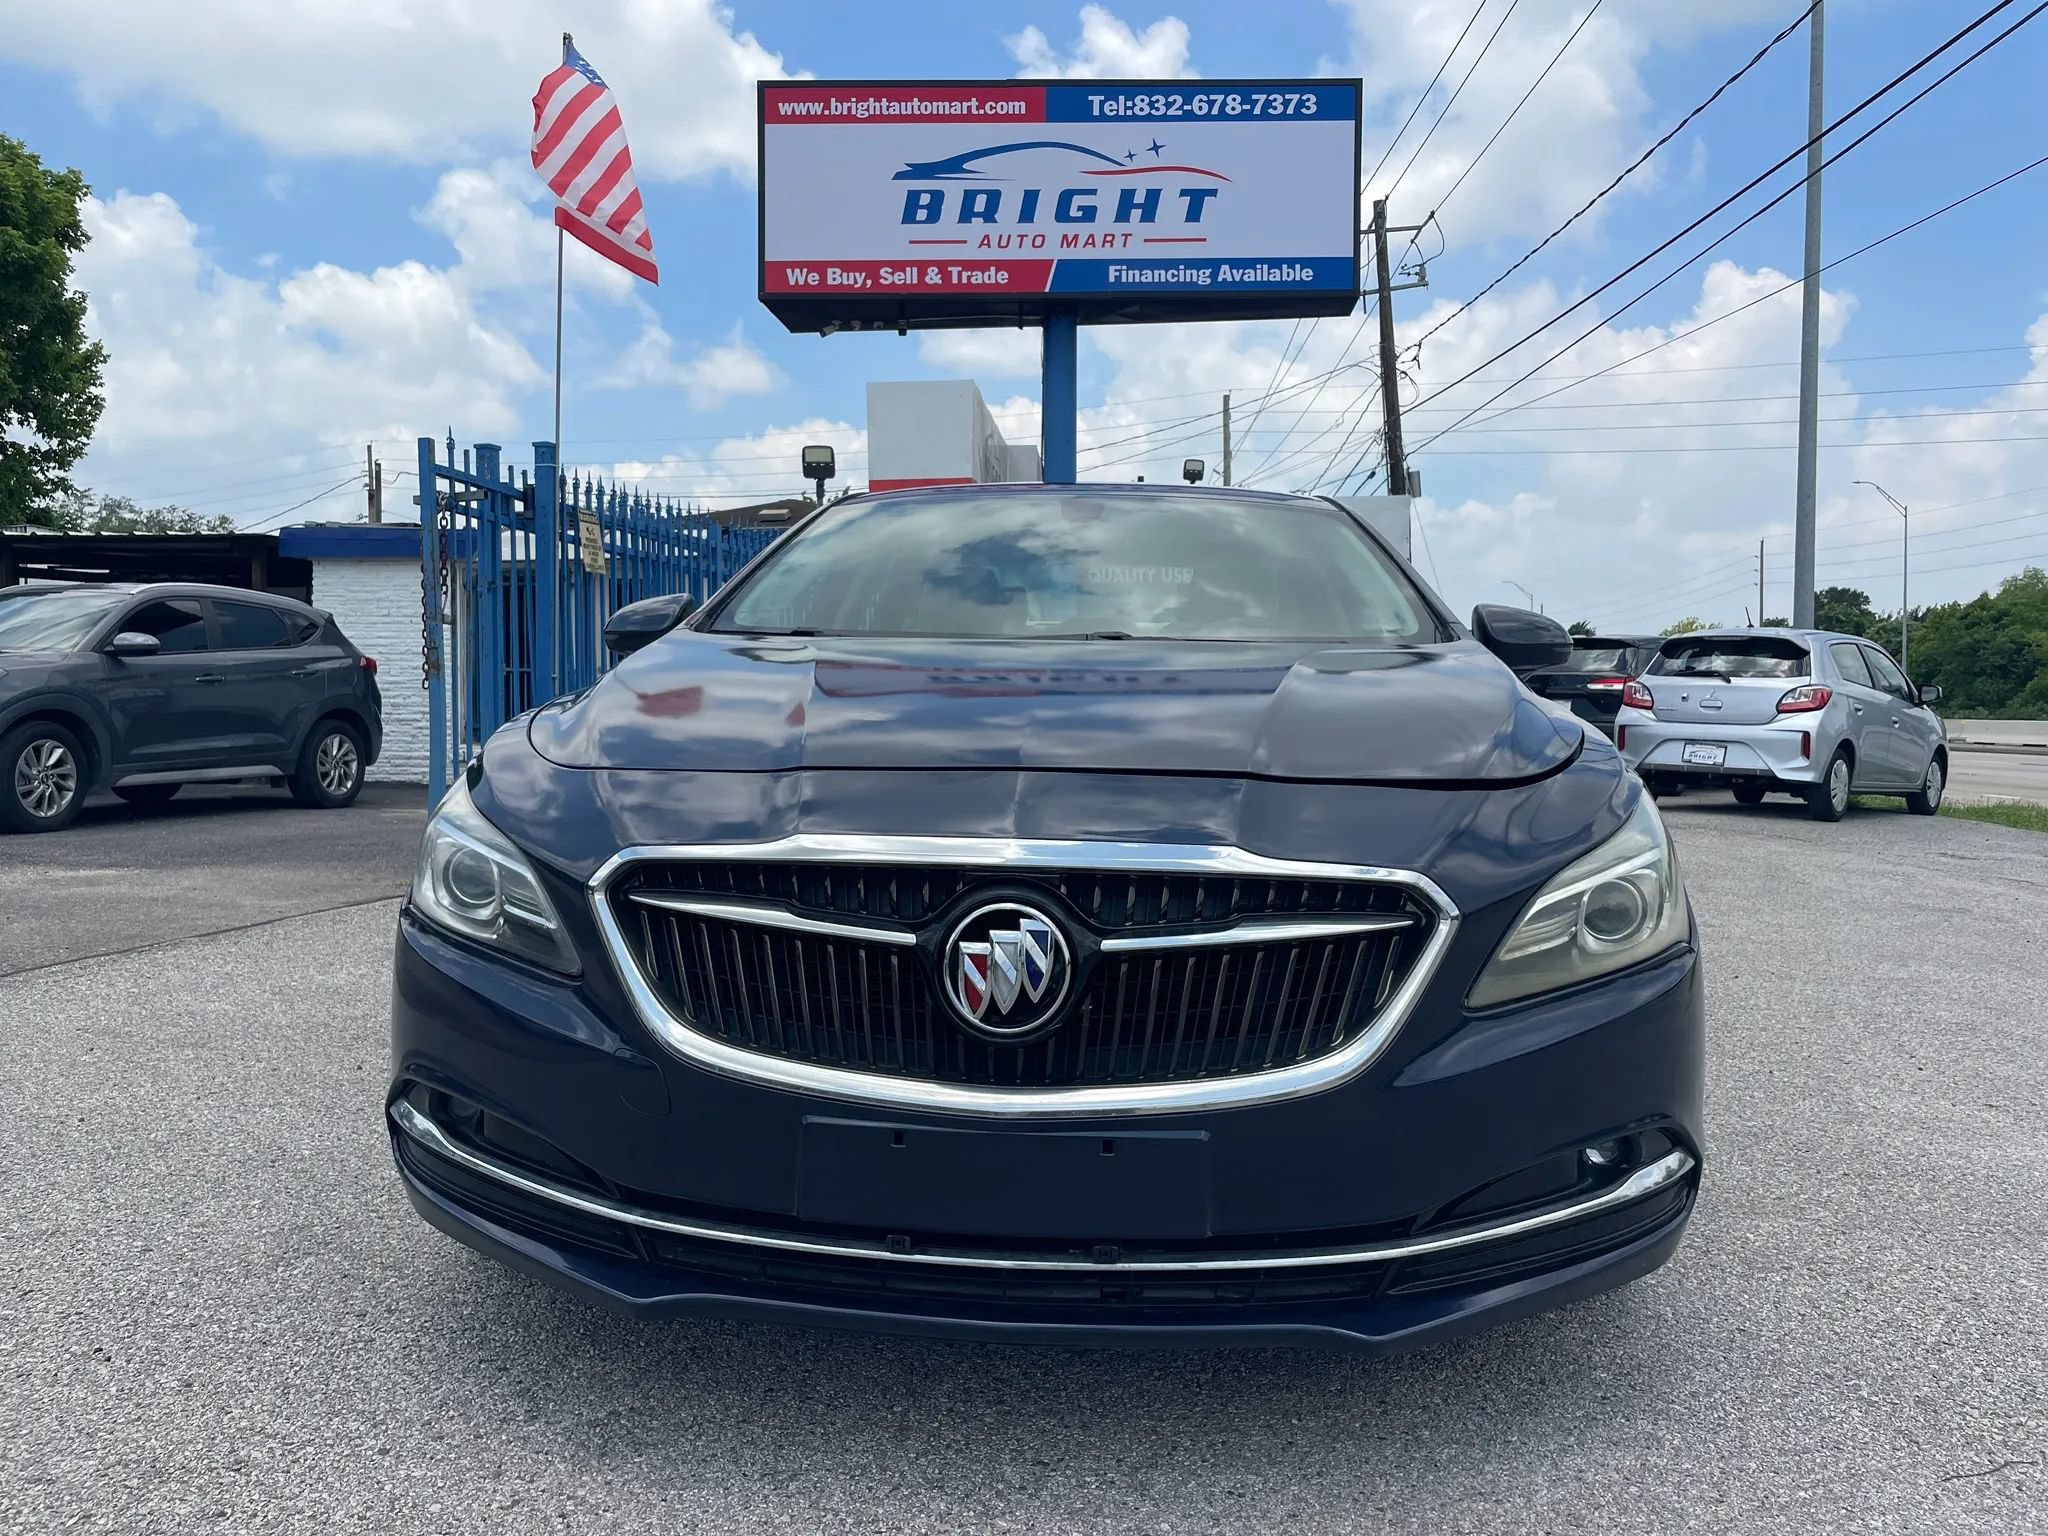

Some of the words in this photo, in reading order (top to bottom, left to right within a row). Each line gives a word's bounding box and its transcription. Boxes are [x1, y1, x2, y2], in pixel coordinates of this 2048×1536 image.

[778, 97, 1026, 118] www.brightautomart.com
[1088, 93, 1318, 116] Tel:832-678-7373
[900, 188, 1218, 225] BRIGHT
[977, 234, 1046, 249] AUTO
[1060, 233, 1133, 248] MART
[786, 268, 820, 286] We
[827, 268, 873, 289] Buy,
[879, 267, 918, 285] Sell
[924, 267, 942, 284] &
[948, 266, 1009, 284] Trade
[1108, 265, 1212, 285] Financing
[1217, 264, 1314, 282] Available
[1088, 567, 1155, 583] QUALITY
